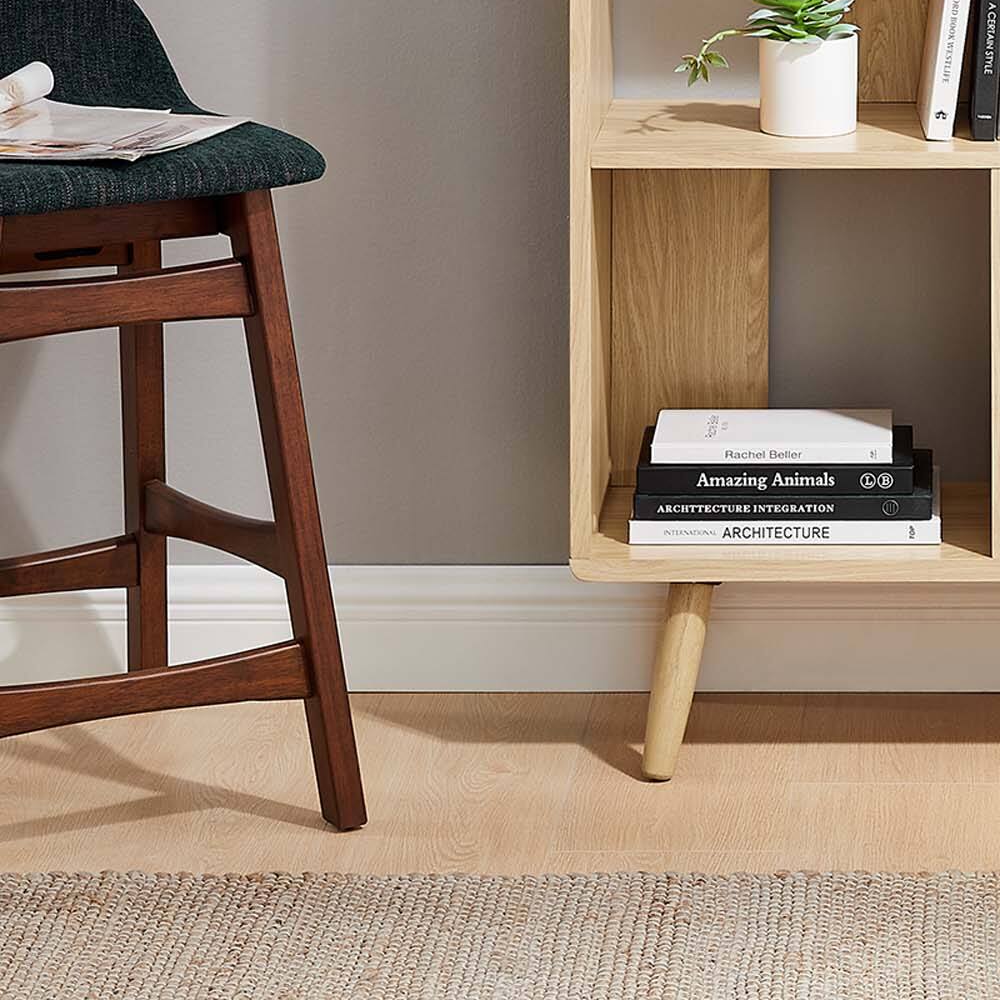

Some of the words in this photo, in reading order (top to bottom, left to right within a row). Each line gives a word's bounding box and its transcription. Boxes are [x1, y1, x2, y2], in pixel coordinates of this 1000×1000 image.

[988, 2, 997, 10] A
[985, 11, 997, 51] CERTAIN
[983, 51, 995, 75] STYLE
[724, 449, 766, 460] Rachel
[769, 449, 802, 460] Beller
[696, 473, 768, 490] Amazing
[771, 472, 835, 487] Animals
[753, 504, 835, 513] INTEGRATION
[722, 527, 830, 539] ARCHITECTURE
